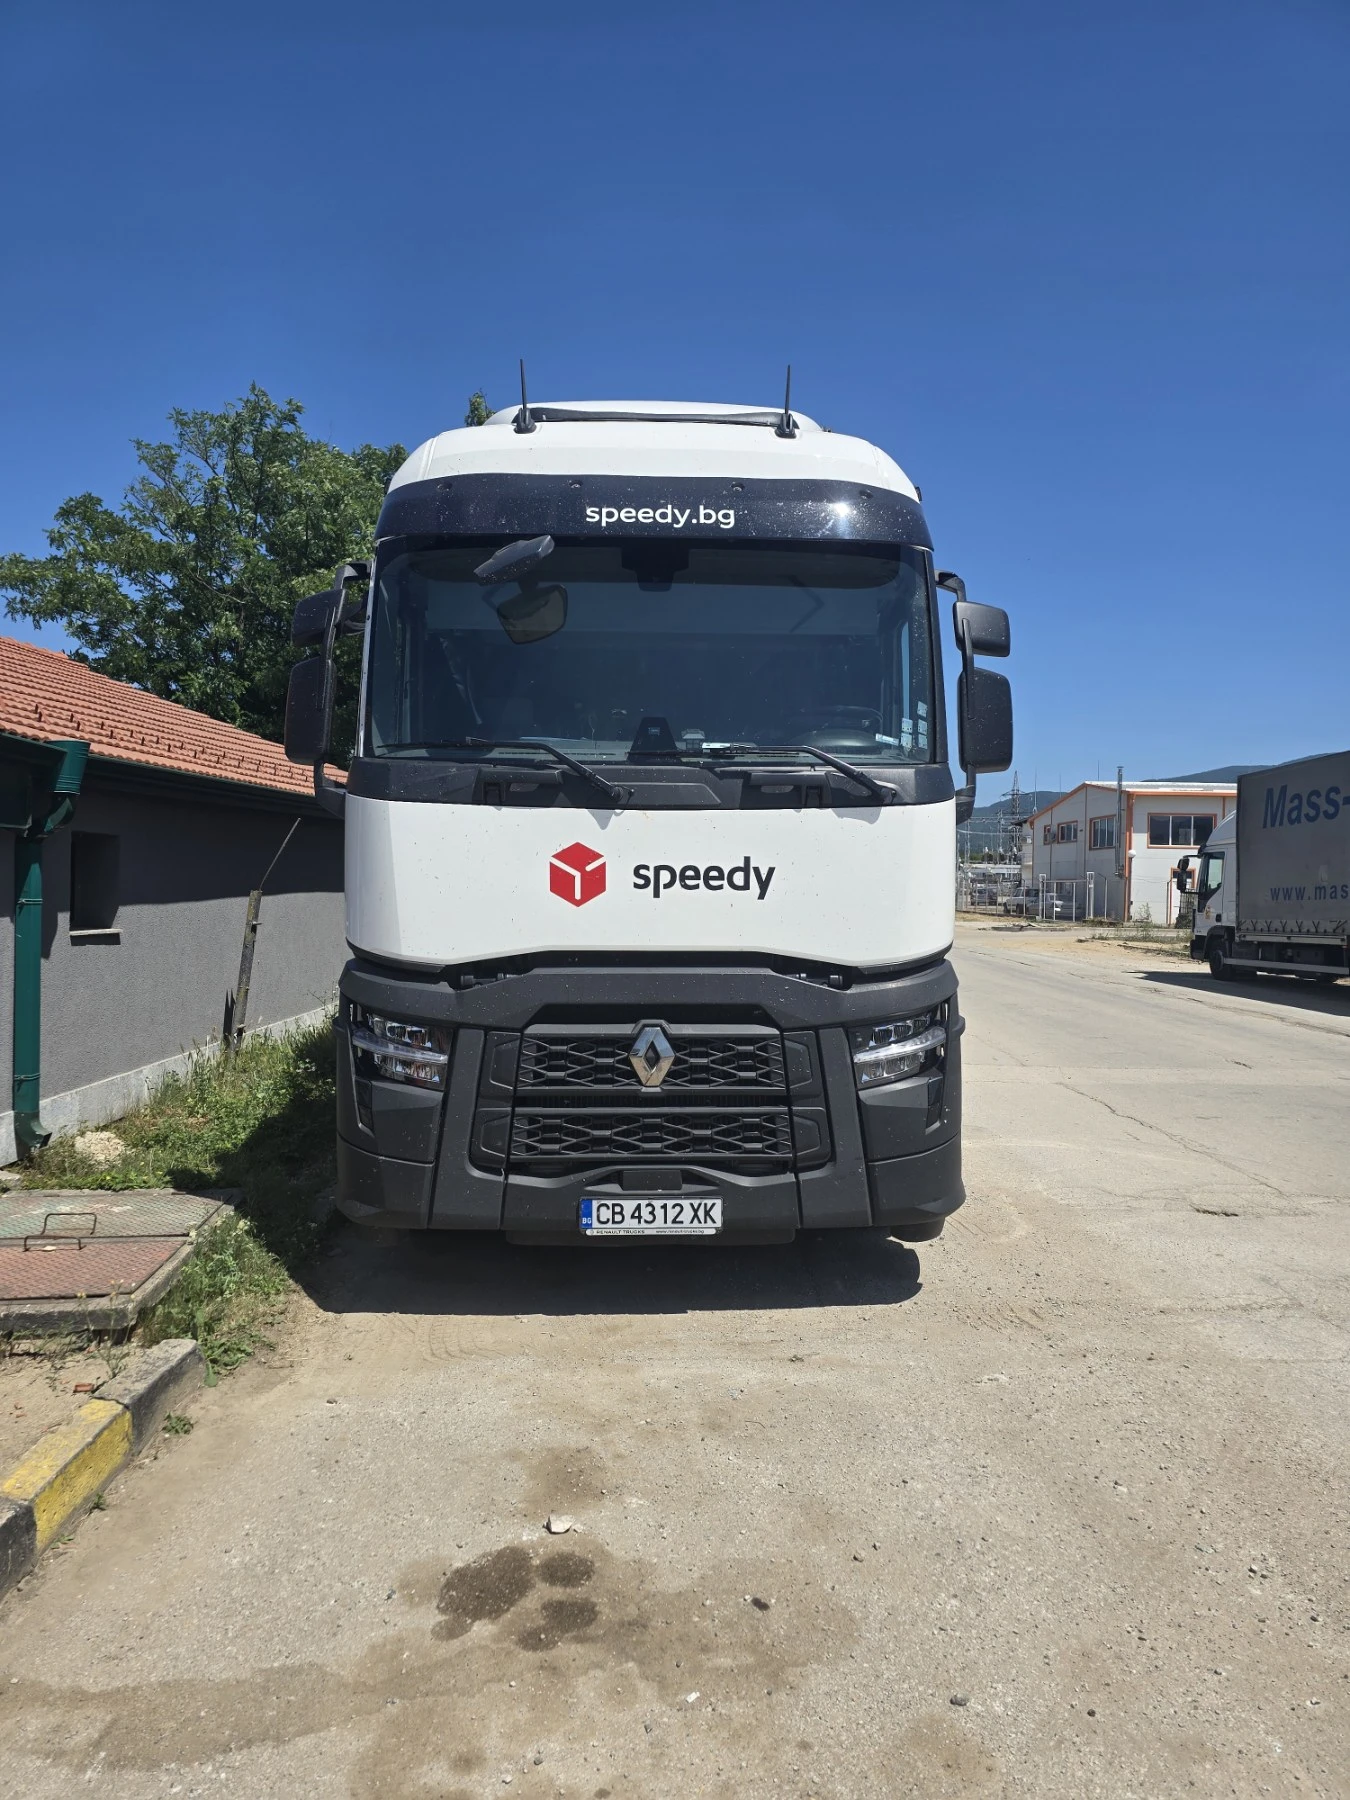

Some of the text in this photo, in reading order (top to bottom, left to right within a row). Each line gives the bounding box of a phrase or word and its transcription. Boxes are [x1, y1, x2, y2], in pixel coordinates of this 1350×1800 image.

[585, 504, 735, 529] speedy.bg
[633, 856, 776, 900] speedy
[1270, 884, 1349, 901] www.mas
[596, 1202, 717, 1225] CB 4312 XK
